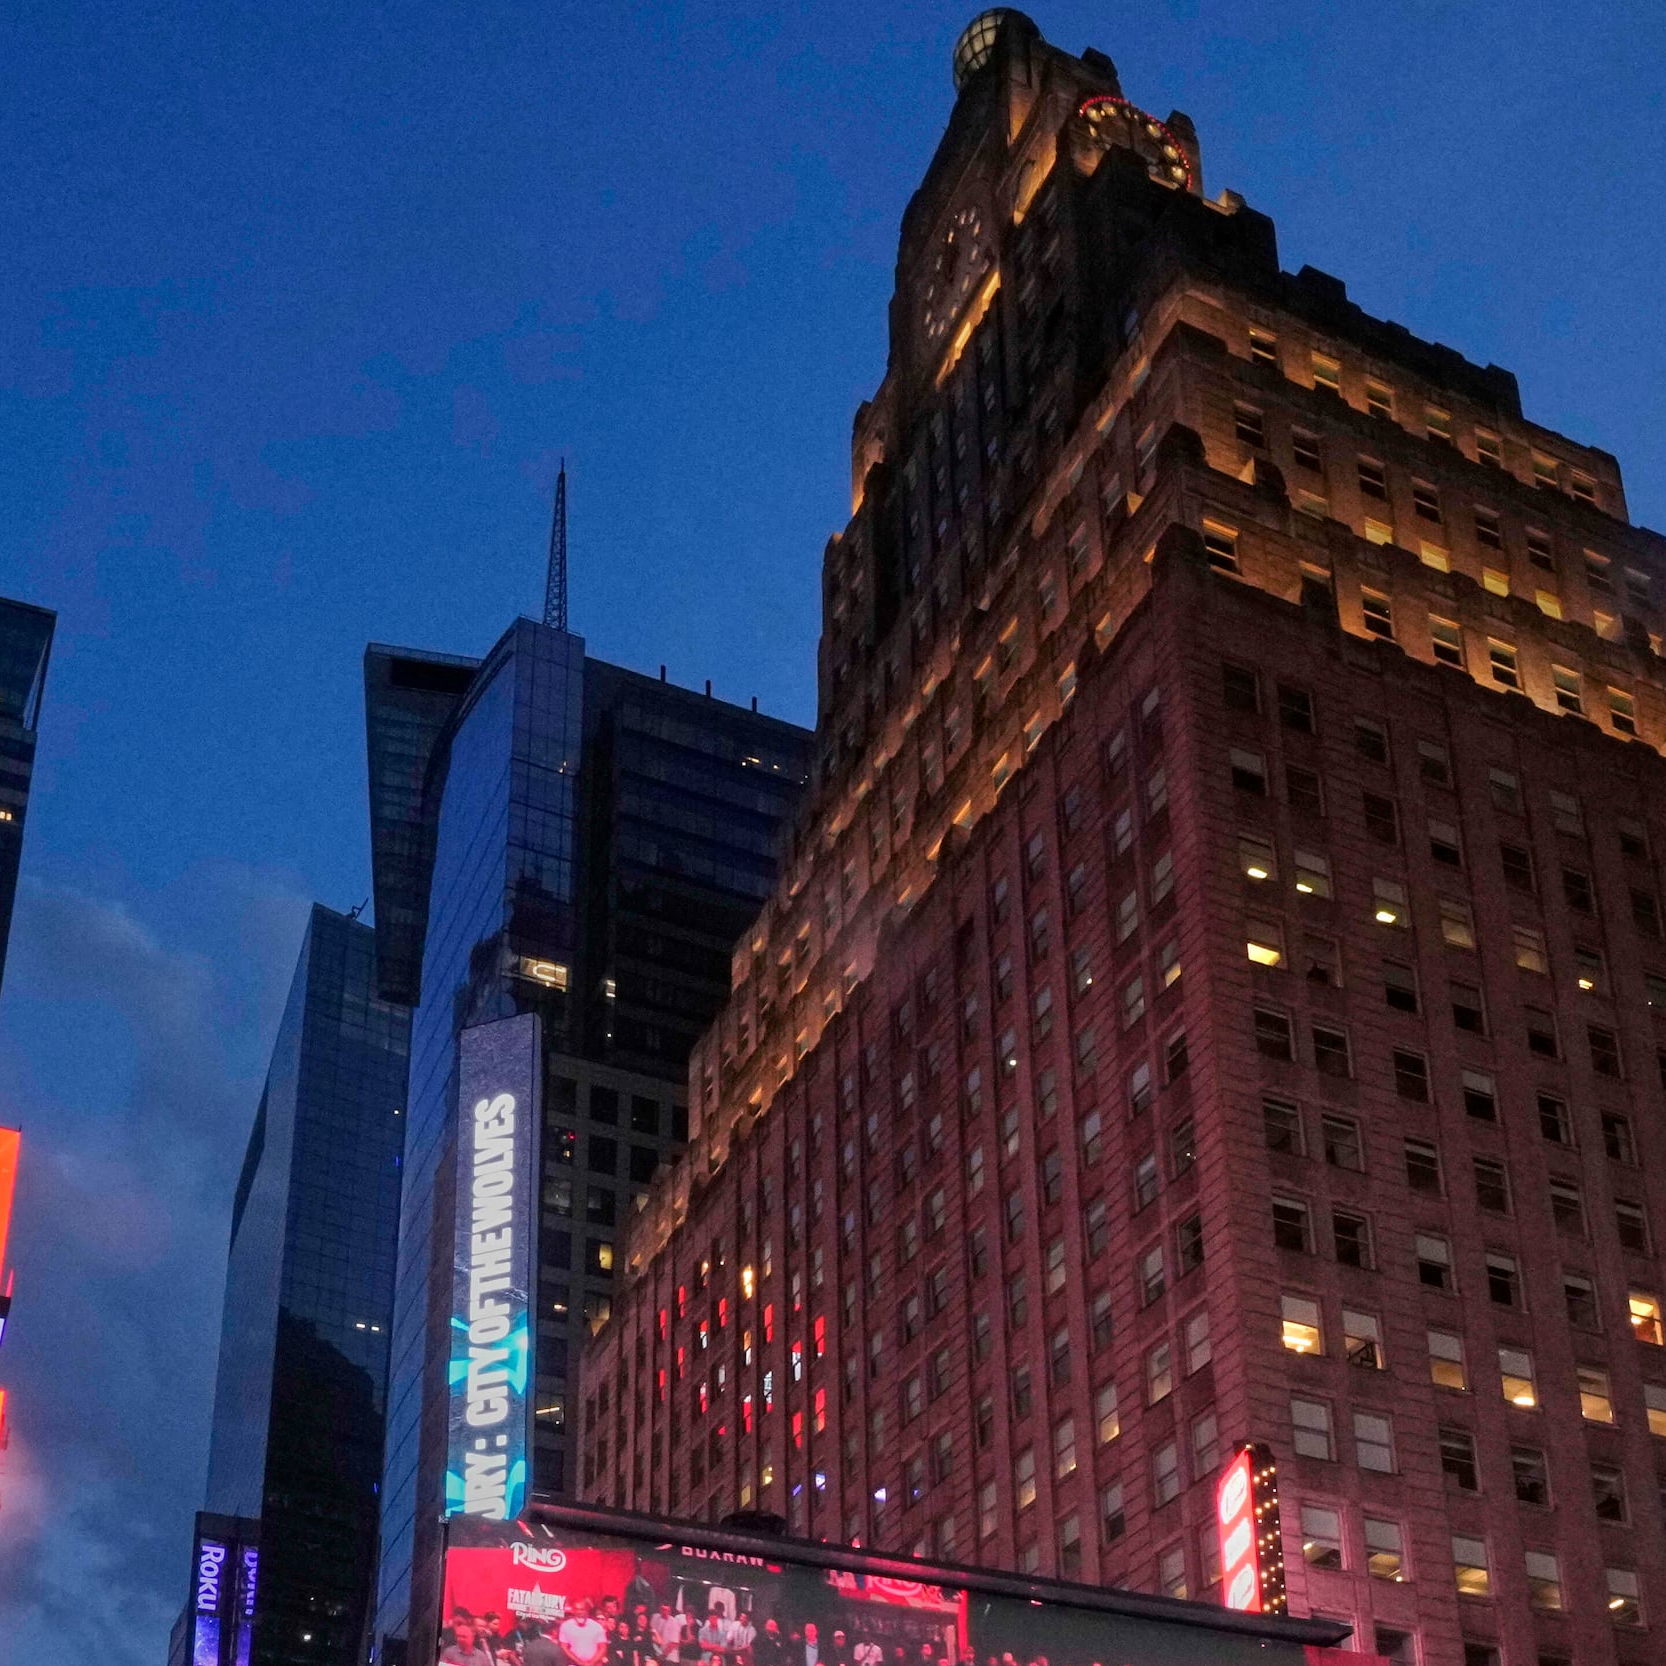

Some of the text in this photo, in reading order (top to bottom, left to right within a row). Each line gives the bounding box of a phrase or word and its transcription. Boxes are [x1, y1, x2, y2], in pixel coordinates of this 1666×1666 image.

[472, 1093, 515, 1231] WOLVES
[471, 1227, 513, 1297] THE
[469, 1297, 510, 1347] OF
[466, 1347, 509, 1427] CITY
[510, 1541, 566, 1573] RING
